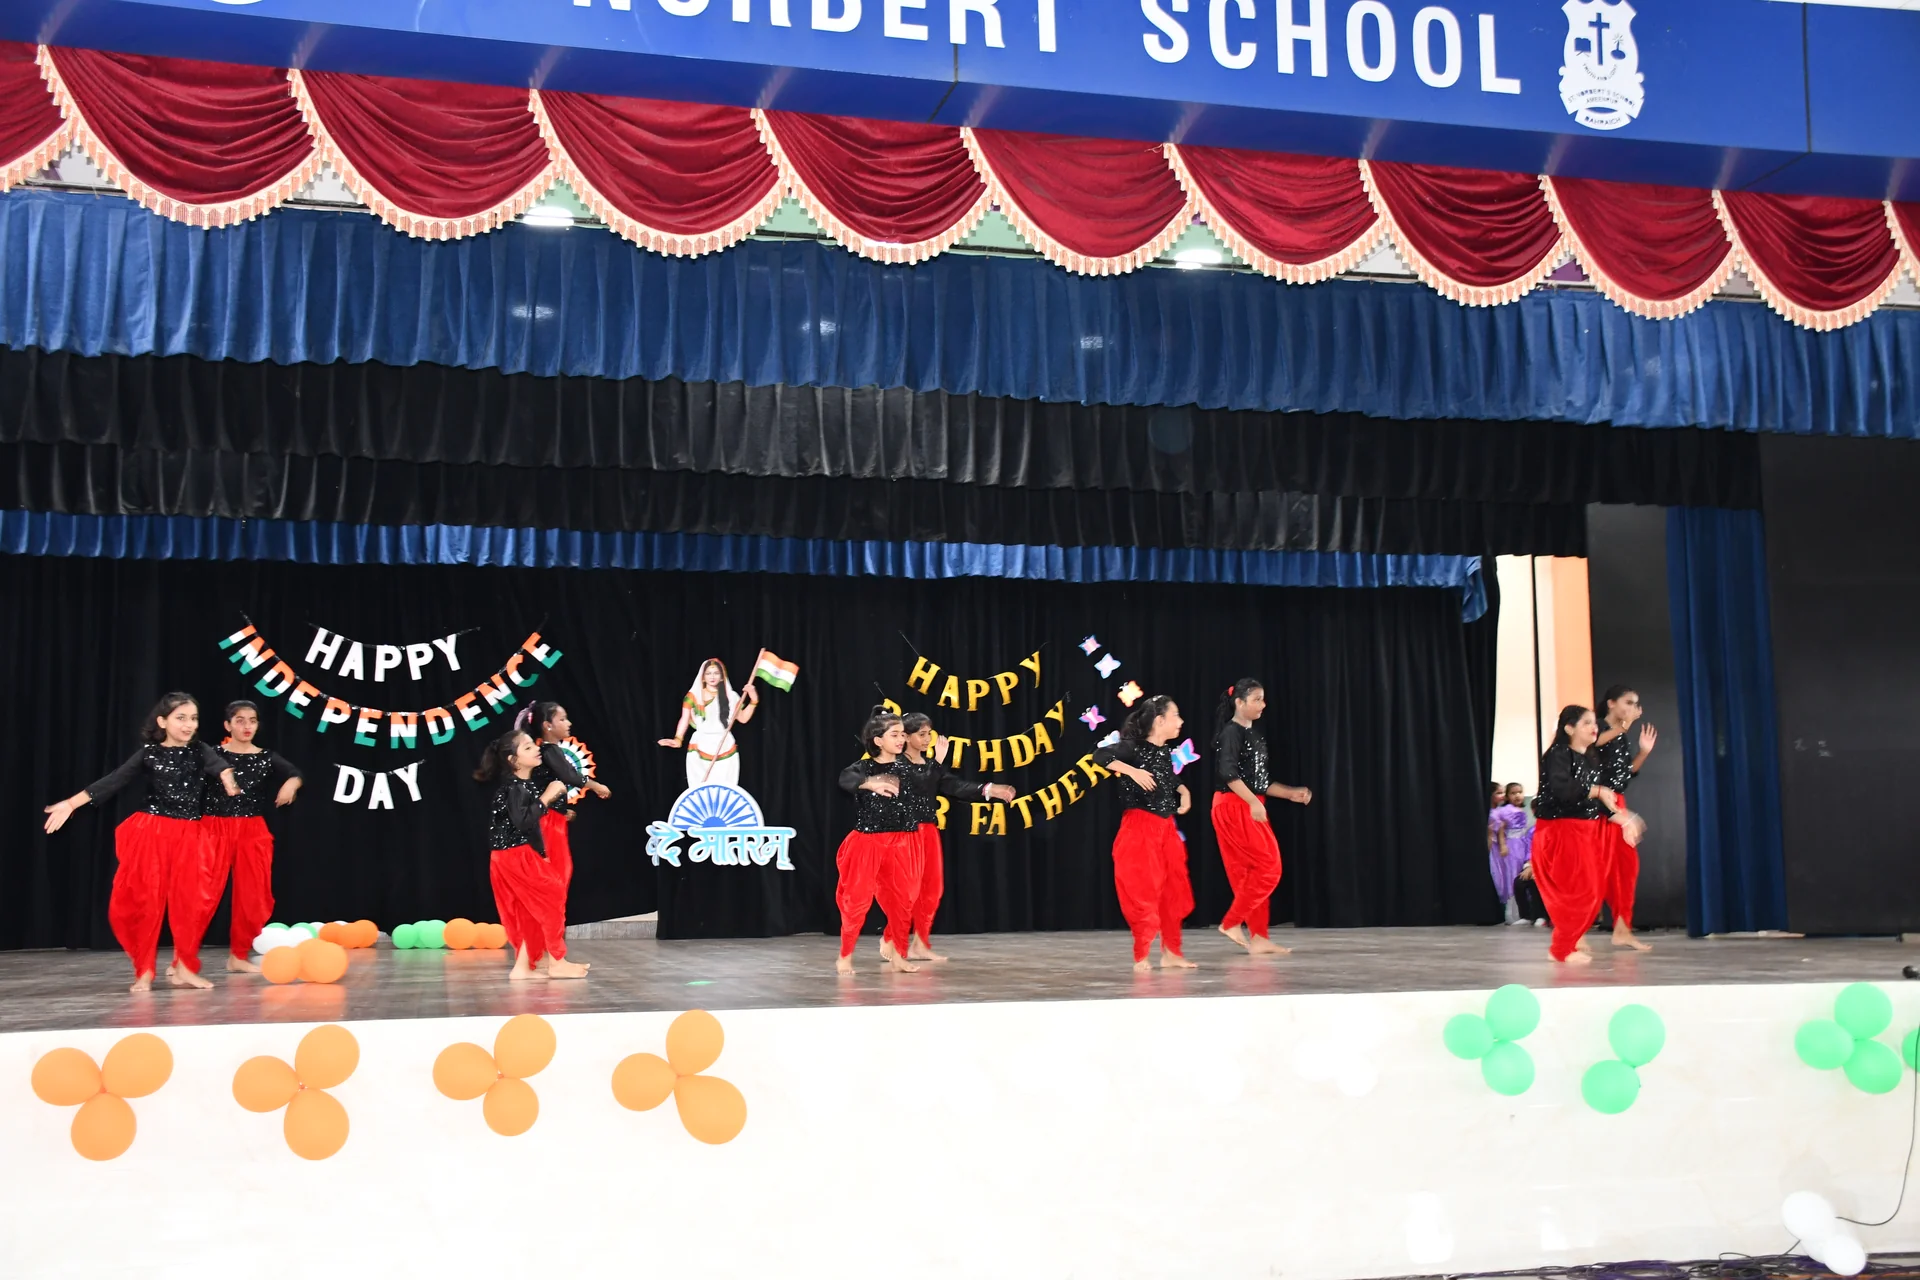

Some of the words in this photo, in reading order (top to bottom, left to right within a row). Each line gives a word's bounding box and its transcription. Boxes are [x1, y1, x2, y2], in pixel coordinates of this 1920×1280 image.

[1141, 0, 1521, 95] SCHOOL
[304, 627, 461, 682] HAPPY
[906, 650, 1042, 712] HAPPY
[218, 624, 564, 749] INDEPENDENCE
[333, 763, 423, 809] DAY
[970, 754, 1112, 836] FATHER
[687, 826, 797, 870] मातरम्
